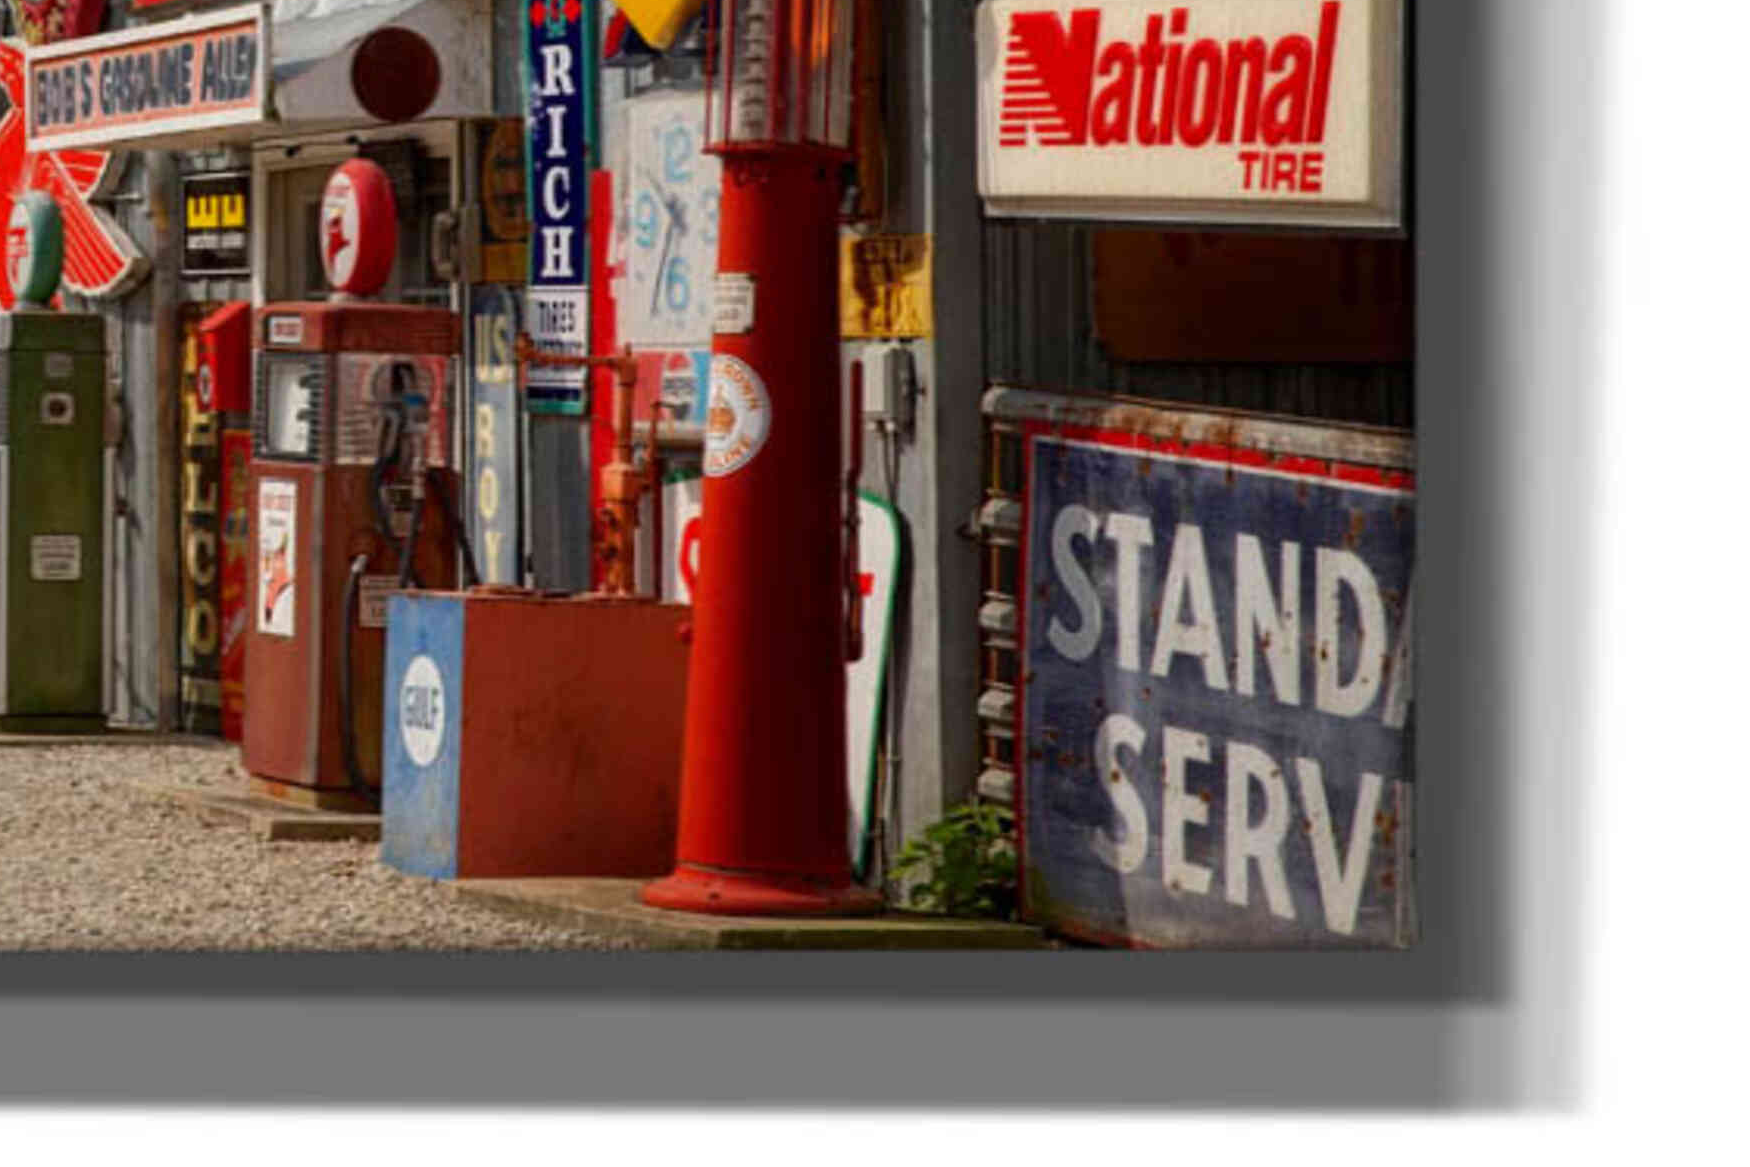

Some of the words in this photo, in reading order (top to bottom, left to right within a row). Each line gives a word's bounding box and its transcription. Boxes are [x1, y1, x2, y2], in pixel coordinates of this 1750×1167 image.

[100, 42, 195, 116] GASOLINE
[999, 0, 1342, 148] National
[1237, 150, 1325, 193] TIRE
[1092, 713, 1383, 935] SERV
